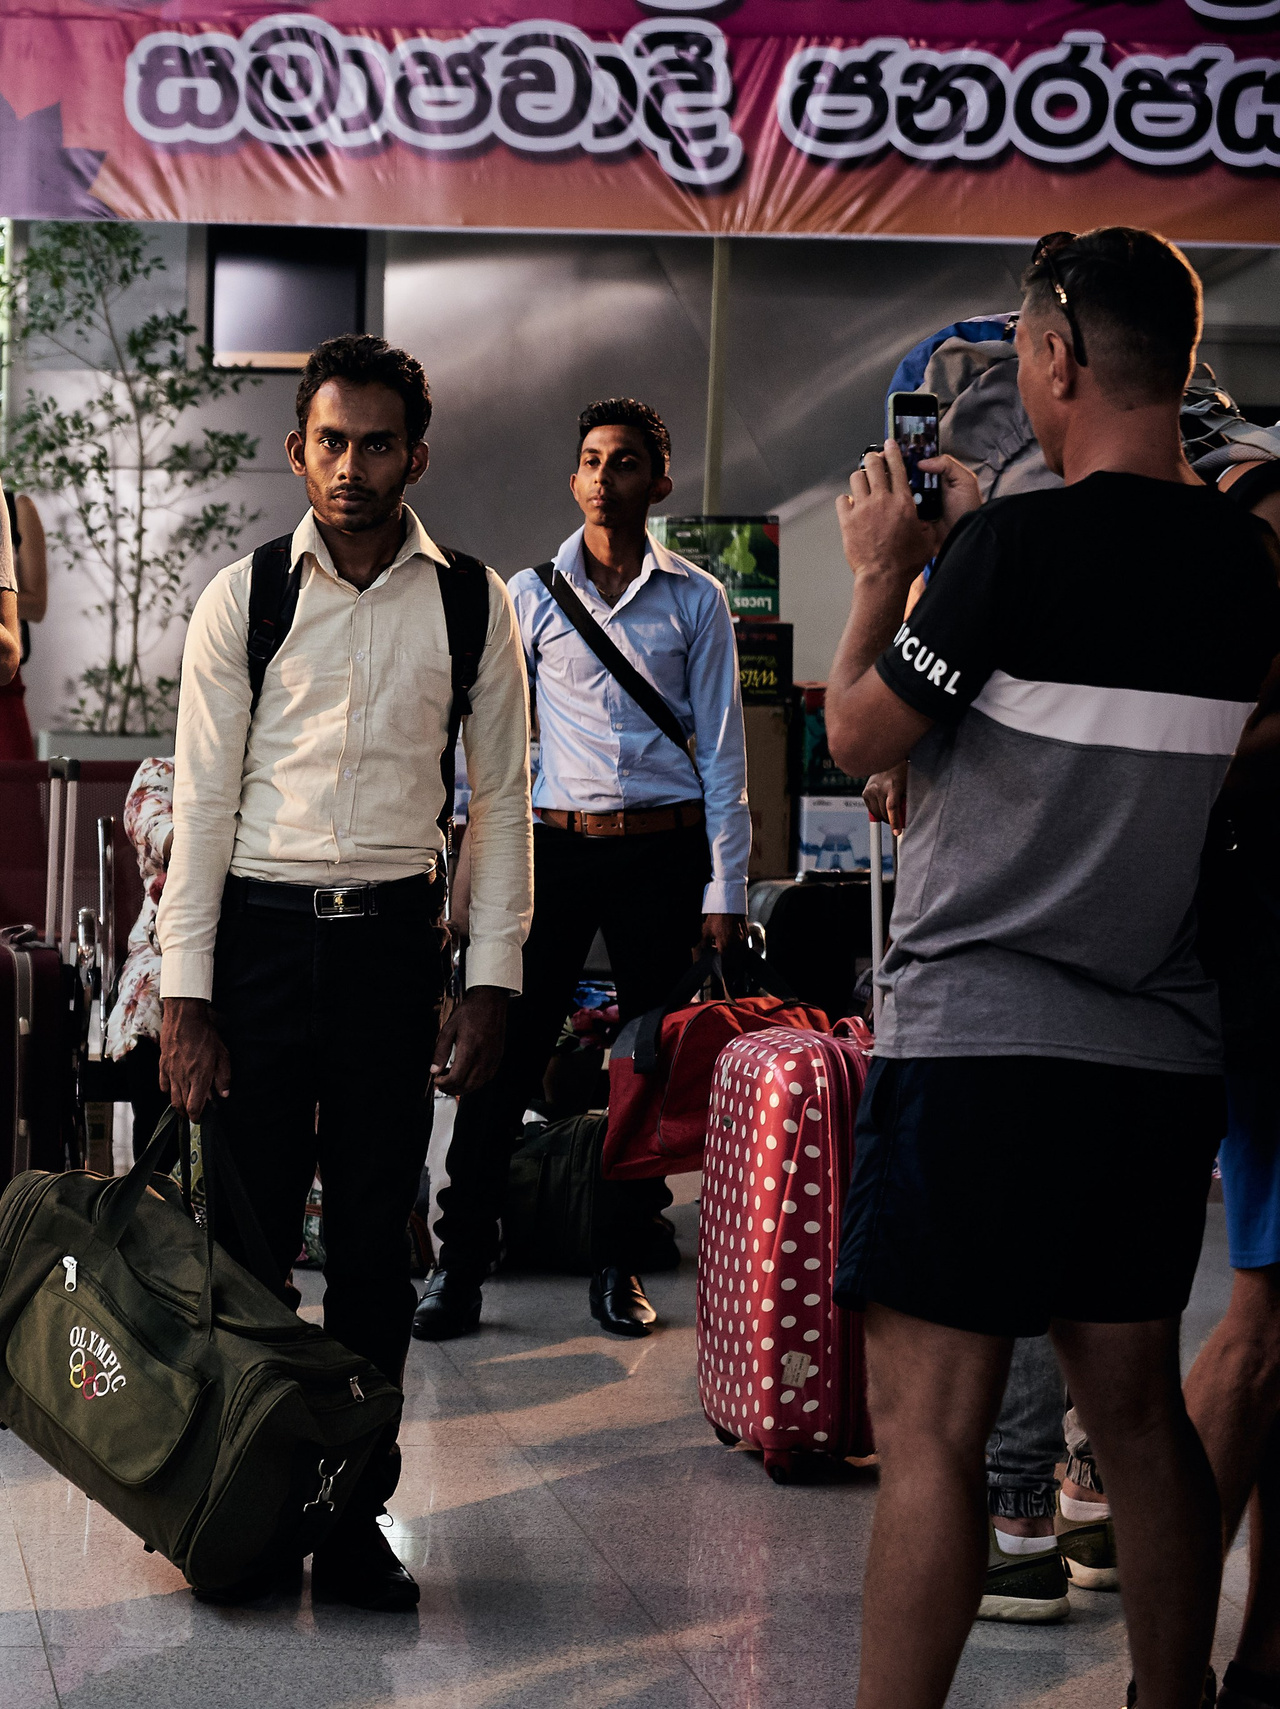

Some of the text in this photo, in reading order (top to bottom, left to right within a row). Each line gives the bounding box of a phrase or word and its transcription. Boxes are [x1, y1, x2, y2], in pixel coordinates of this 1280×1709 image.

[126, 15, 742, 183] සමාජවාදී
[733, 596, 772, 611] Lucas
[739, 669, 778, 688] Wils
[893, 622, 961, 695] IPCURL
[69, 1325, 126, 1393] OLYMPIC
